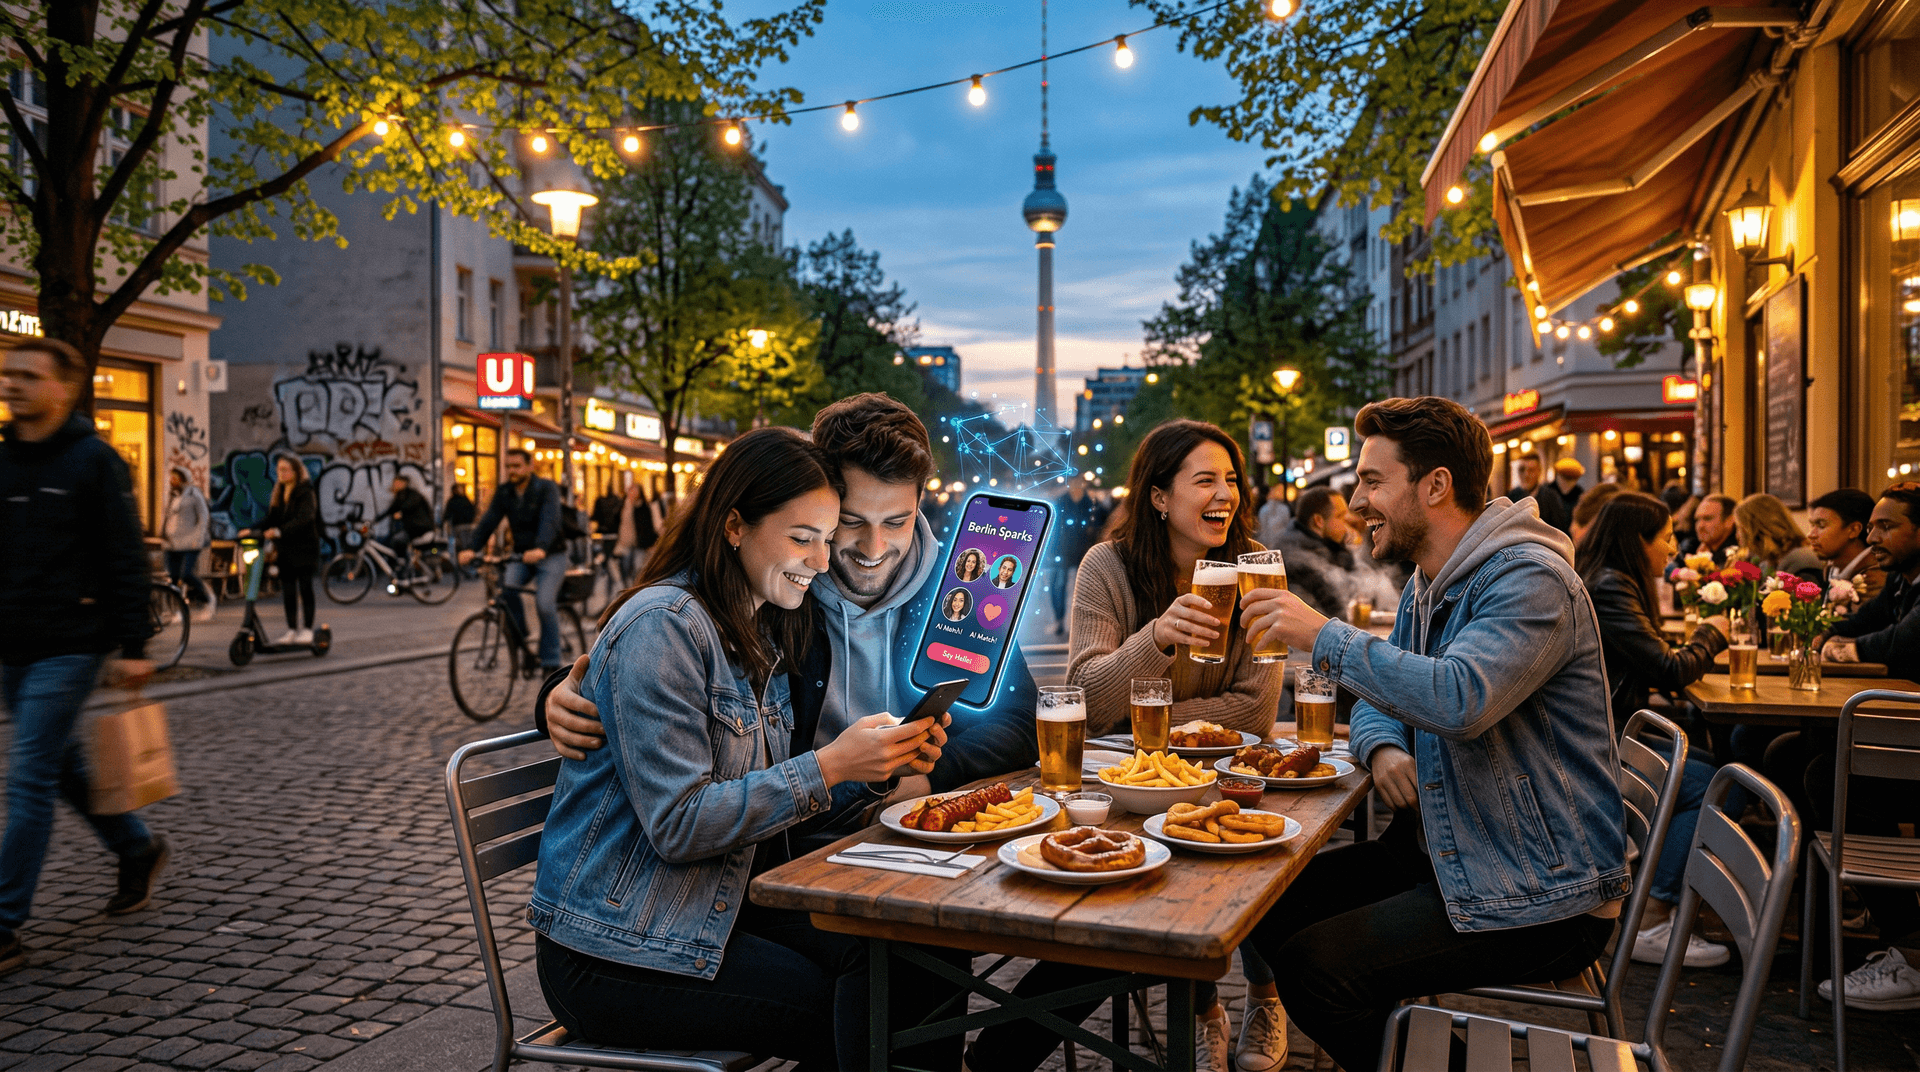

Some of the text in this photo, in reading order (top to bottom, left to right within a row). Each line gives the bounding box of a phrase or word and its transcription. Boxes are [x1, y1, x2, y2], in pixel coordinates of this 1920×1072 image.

[486, 358, 514, 393] U
[967, 521, 1033, 542] Berlin Sparks
[942, 650, 953, 660] Say
